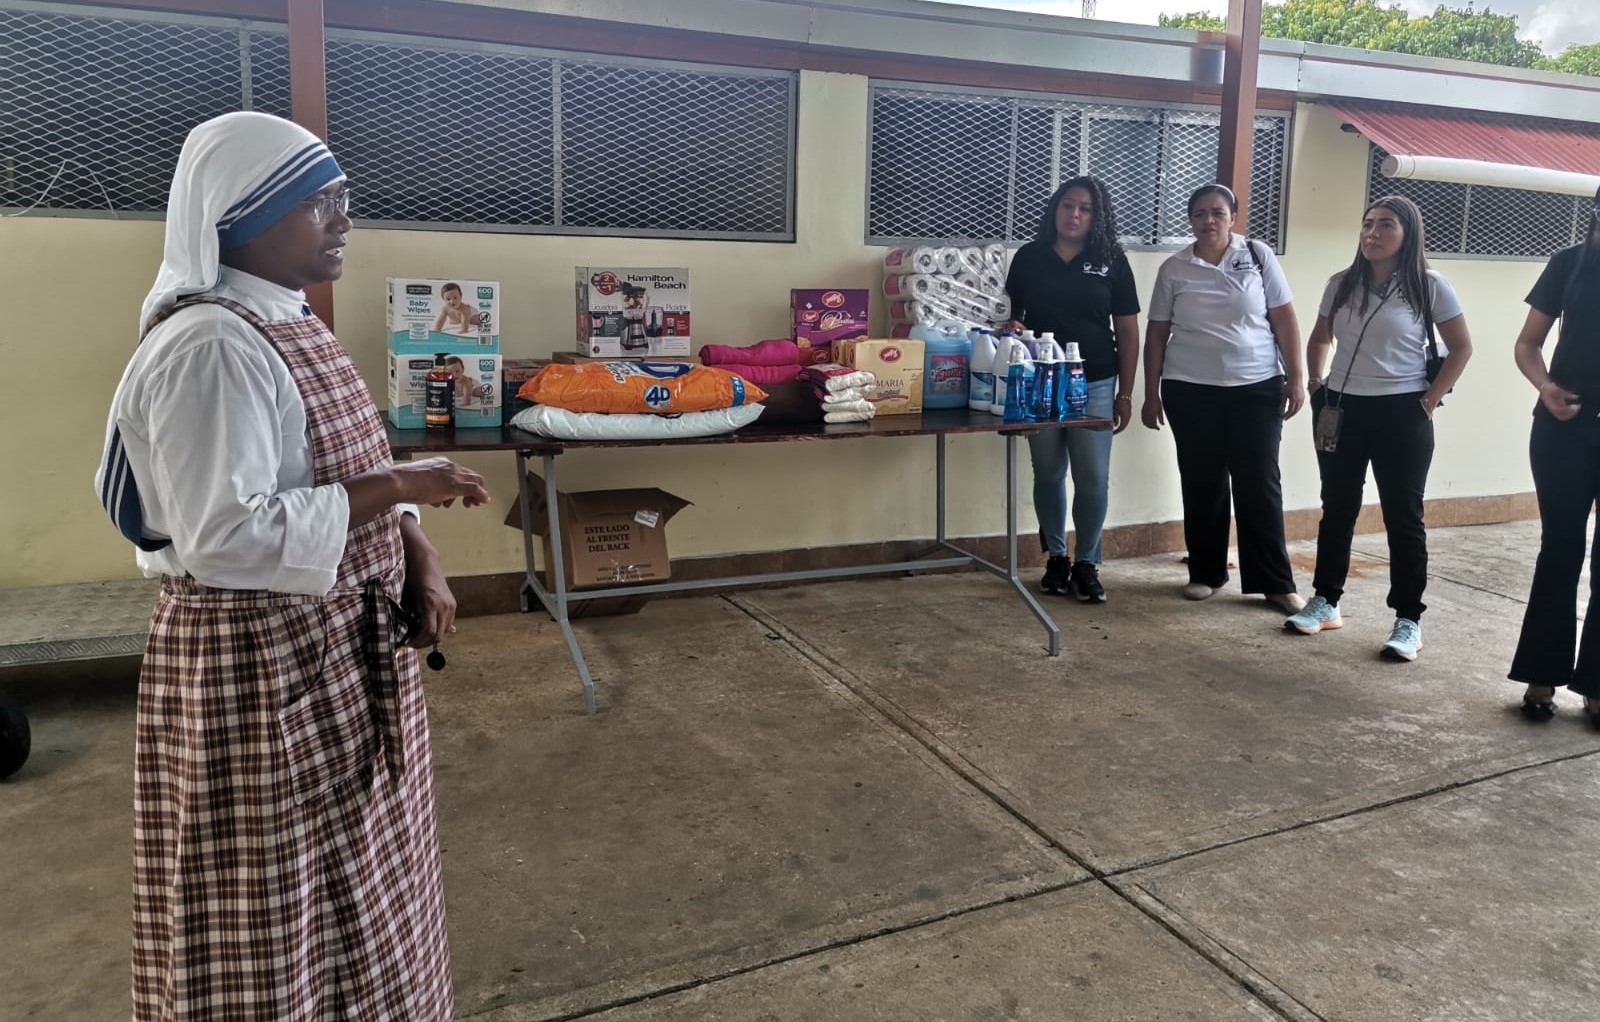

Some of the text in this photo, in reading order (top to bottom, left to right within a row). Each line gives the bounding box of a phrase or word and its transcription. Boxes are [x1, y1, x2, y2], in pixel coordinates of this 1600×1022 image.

[627, 274, 674, 282] Hamilton
[654, 281, 687, 289] Beach
[409, 300, 428, 308] Baby
[407, 306, 431, 314] Wipes
[645, 386, 671, 406] 4D
[584, 525, 630, 535] ESTE LADO
[586, 534, 630, 544] AL FRENTE
[588, 544, 606, 553] DEL
